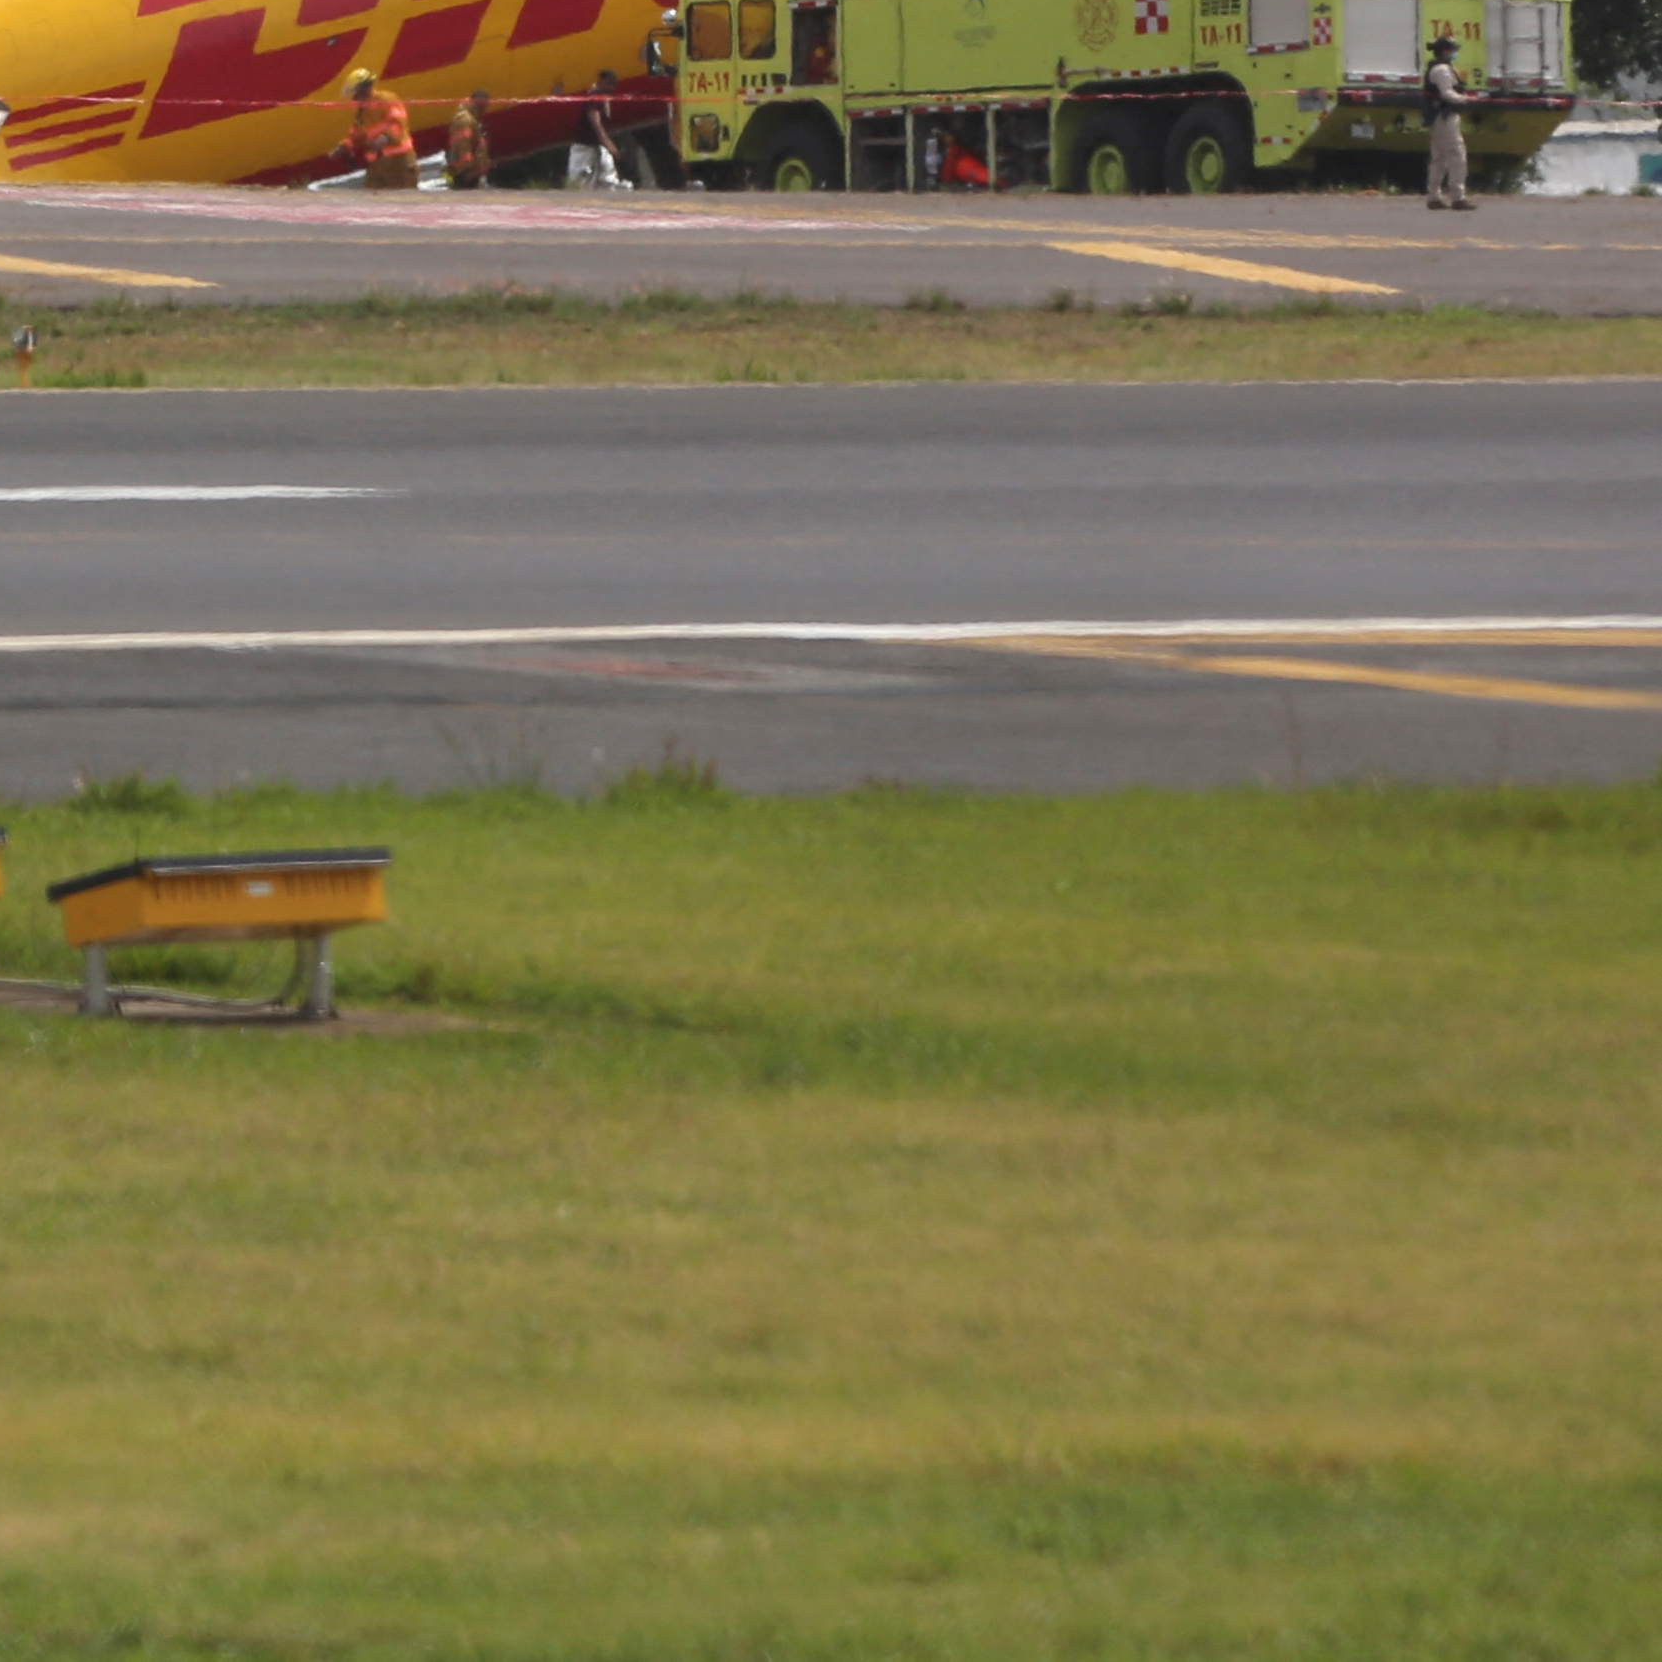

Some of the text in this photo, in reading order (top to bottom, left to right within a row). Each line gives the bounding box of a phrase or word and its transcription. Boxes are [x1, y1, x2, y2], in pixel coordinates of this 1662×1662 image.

[1200, 23, 1242, 46] TA-11
[1430, 19, 1482, 42] TA-11
[688, 72, 730, 94] TA-11
